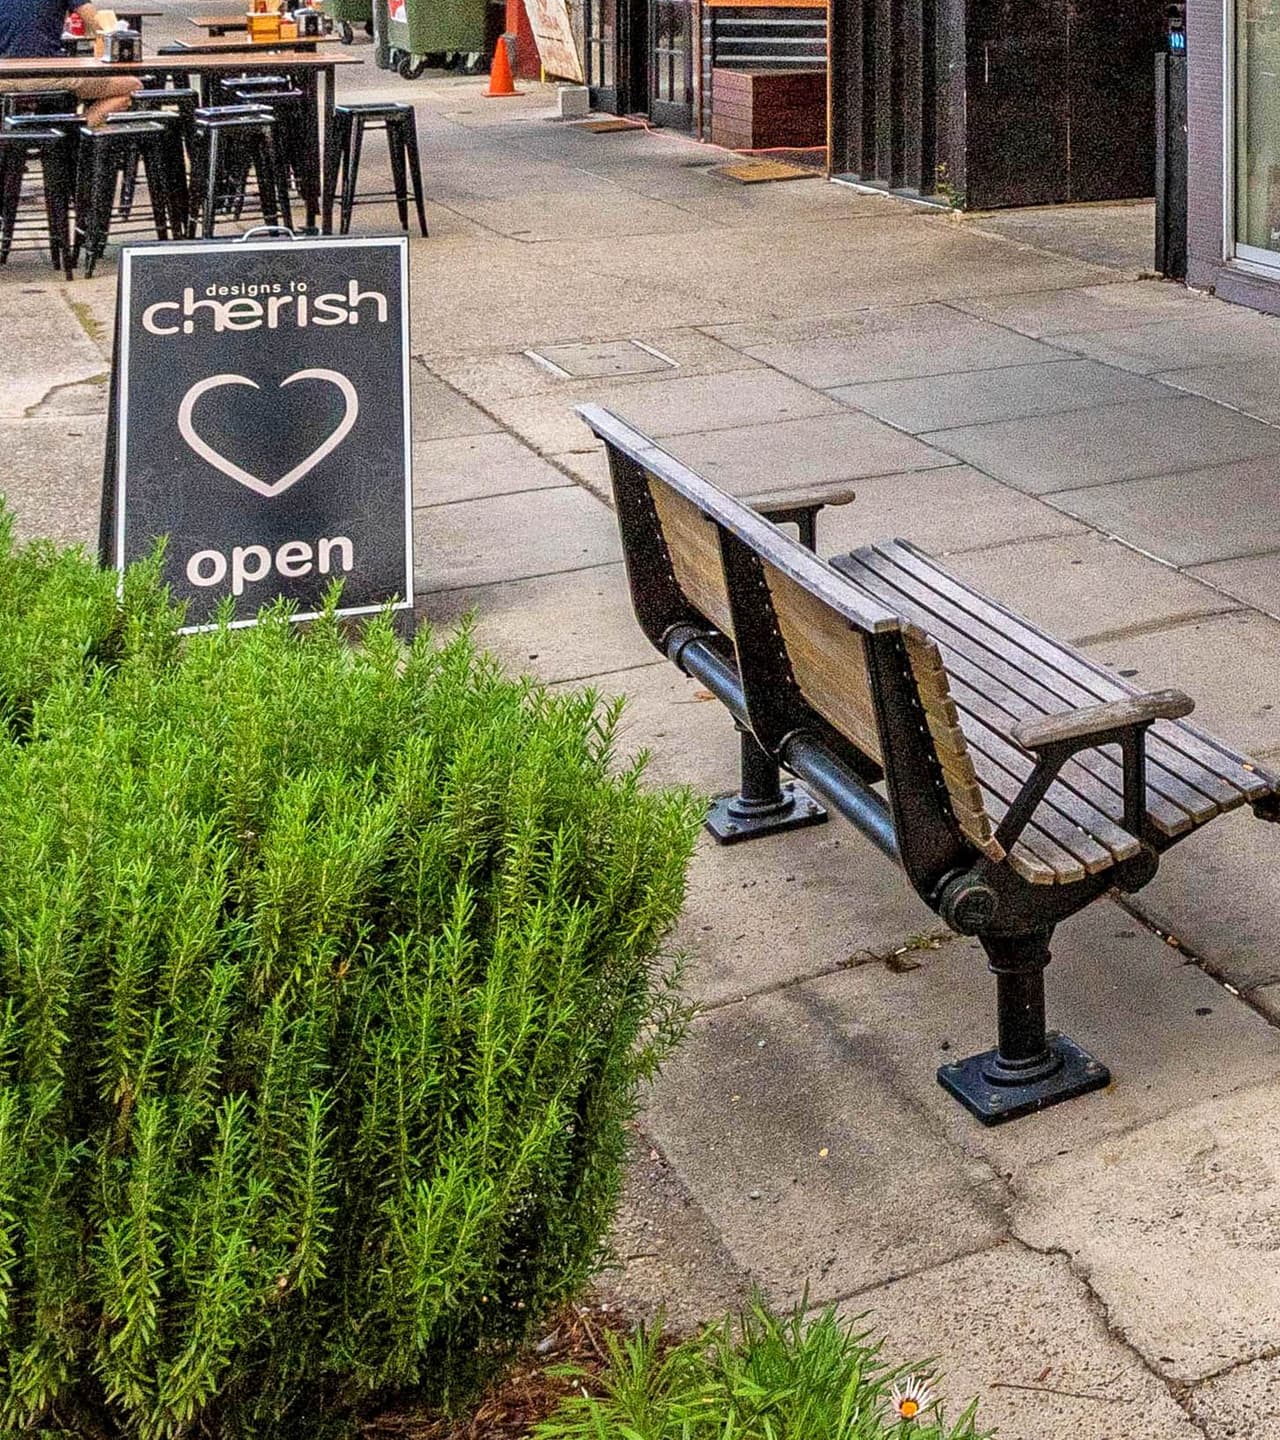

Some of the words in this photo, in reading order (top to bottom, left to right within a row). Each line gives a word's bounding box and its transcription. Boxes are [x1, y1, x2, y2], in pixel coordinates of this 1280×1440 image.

[141, 279, 388, 336] cherish
[206, 281, 281, 297] designs
[290, 280, 308, 293] to
[186, 535, 354, 596] open
